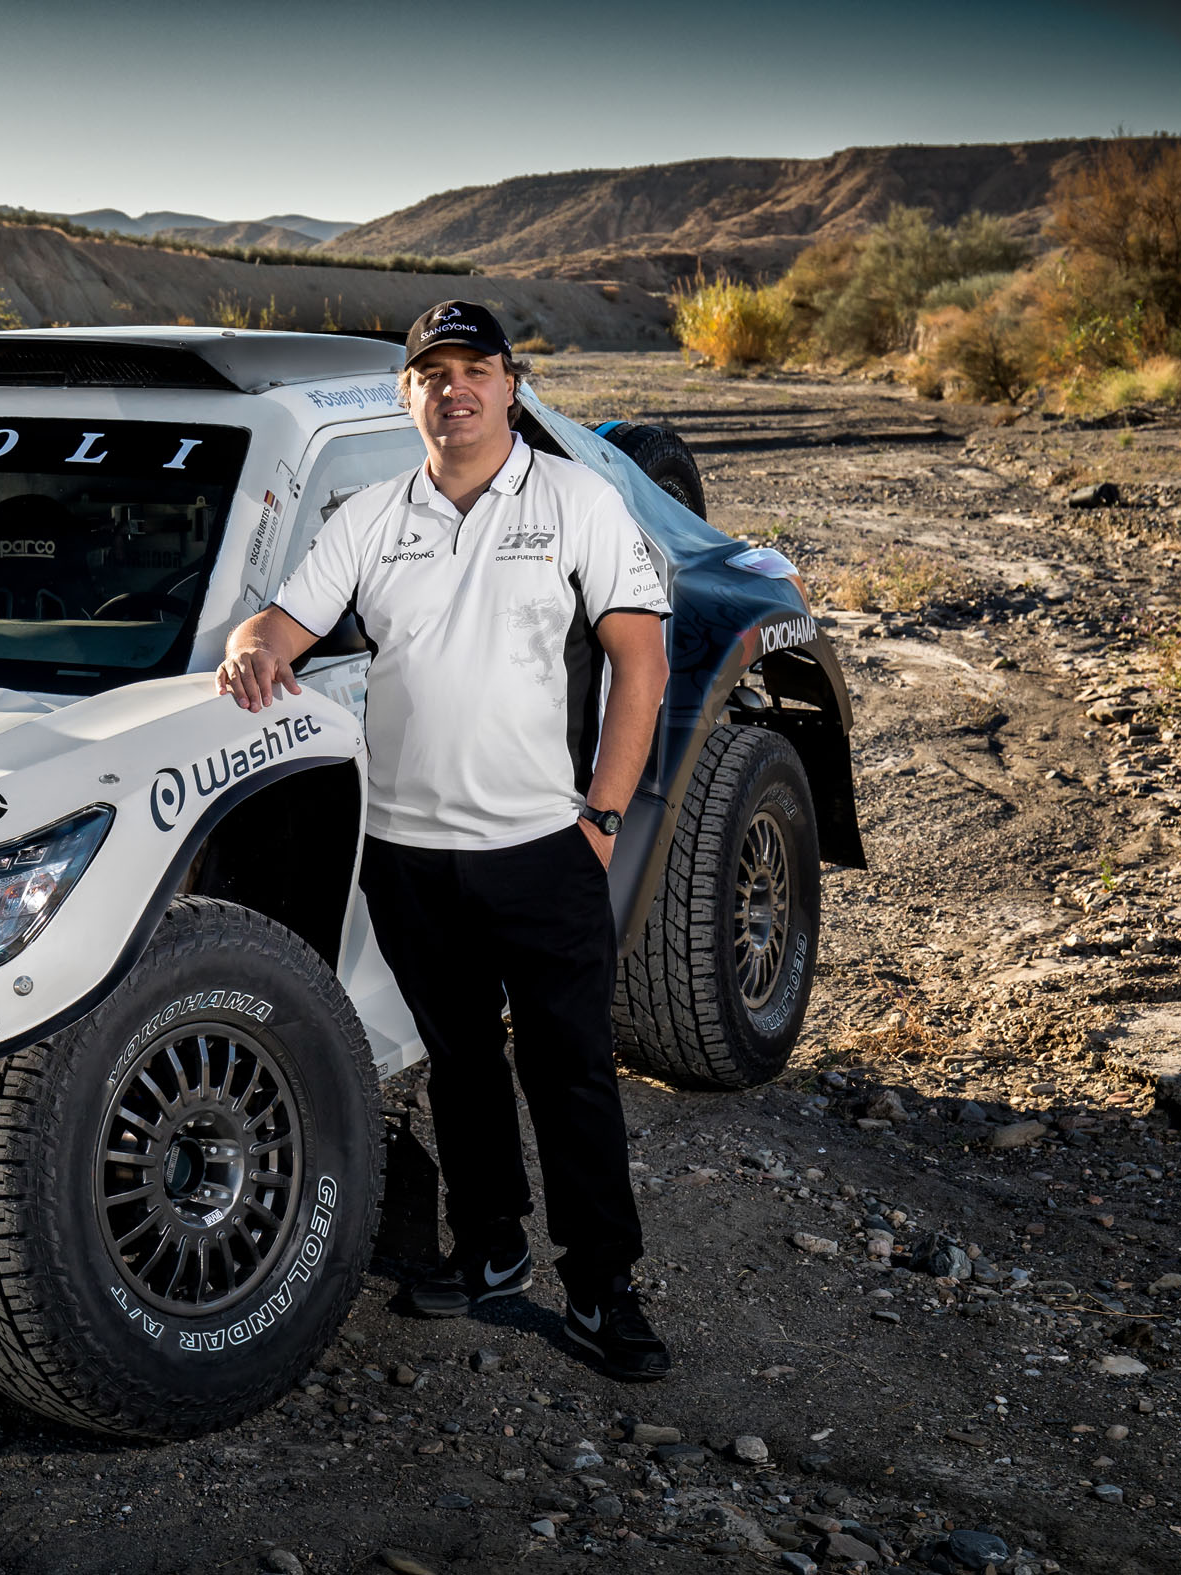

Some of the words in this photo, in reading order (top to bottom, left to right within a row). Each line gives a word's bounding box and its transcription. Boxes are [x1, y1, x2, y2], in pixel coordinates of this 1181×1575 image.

[420, 322, 478, 342] SSANGYONG
[305, 382, 399, 409] #SsangYongD
[249, 538, 263, 567] OSCAR
[257, 506, 271, 539] FUERTES
[259, 549, 271, 577] DIEGO
[266, 516, 279, 550] VALLEJO
[508, 524, 556, 532] TIVOLI
[380, 550, 435, 564] SSANGYONG
[760, 615, 818, 656] YOKOHAMA
[191, 714, 322, 797] WashTec
[106, 989, 274, 1086] YOKOHAMA
[180, 1175, 338, 1352] GEOLANDAR
[110, 1285, 165, 1339] A/T
